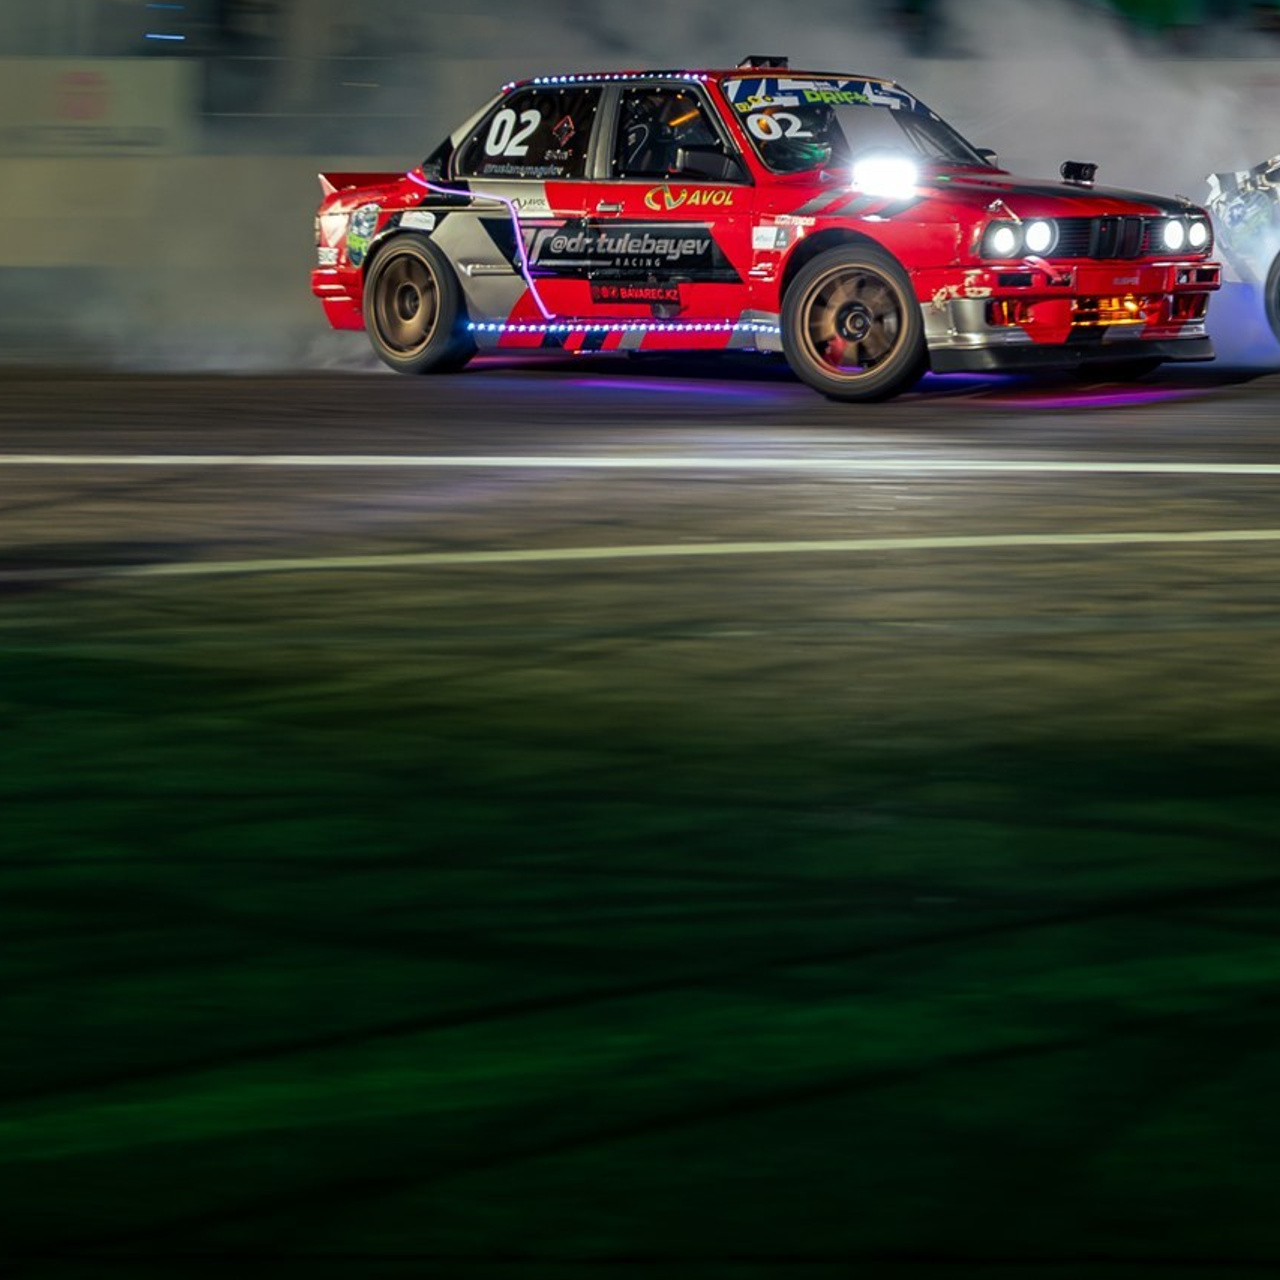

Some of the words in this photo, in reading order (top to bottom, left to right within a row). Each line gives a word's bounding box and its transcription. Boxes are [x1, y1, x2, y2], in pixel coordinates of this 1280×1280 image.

[485, 108, 541, 156] 02
[746, 113, 814, 140] 02
[686, 189, 734, 207] AVOL
[550, 231, 711, 261] @dr.tulebayev
[615, 258, 661, 267] RACING
